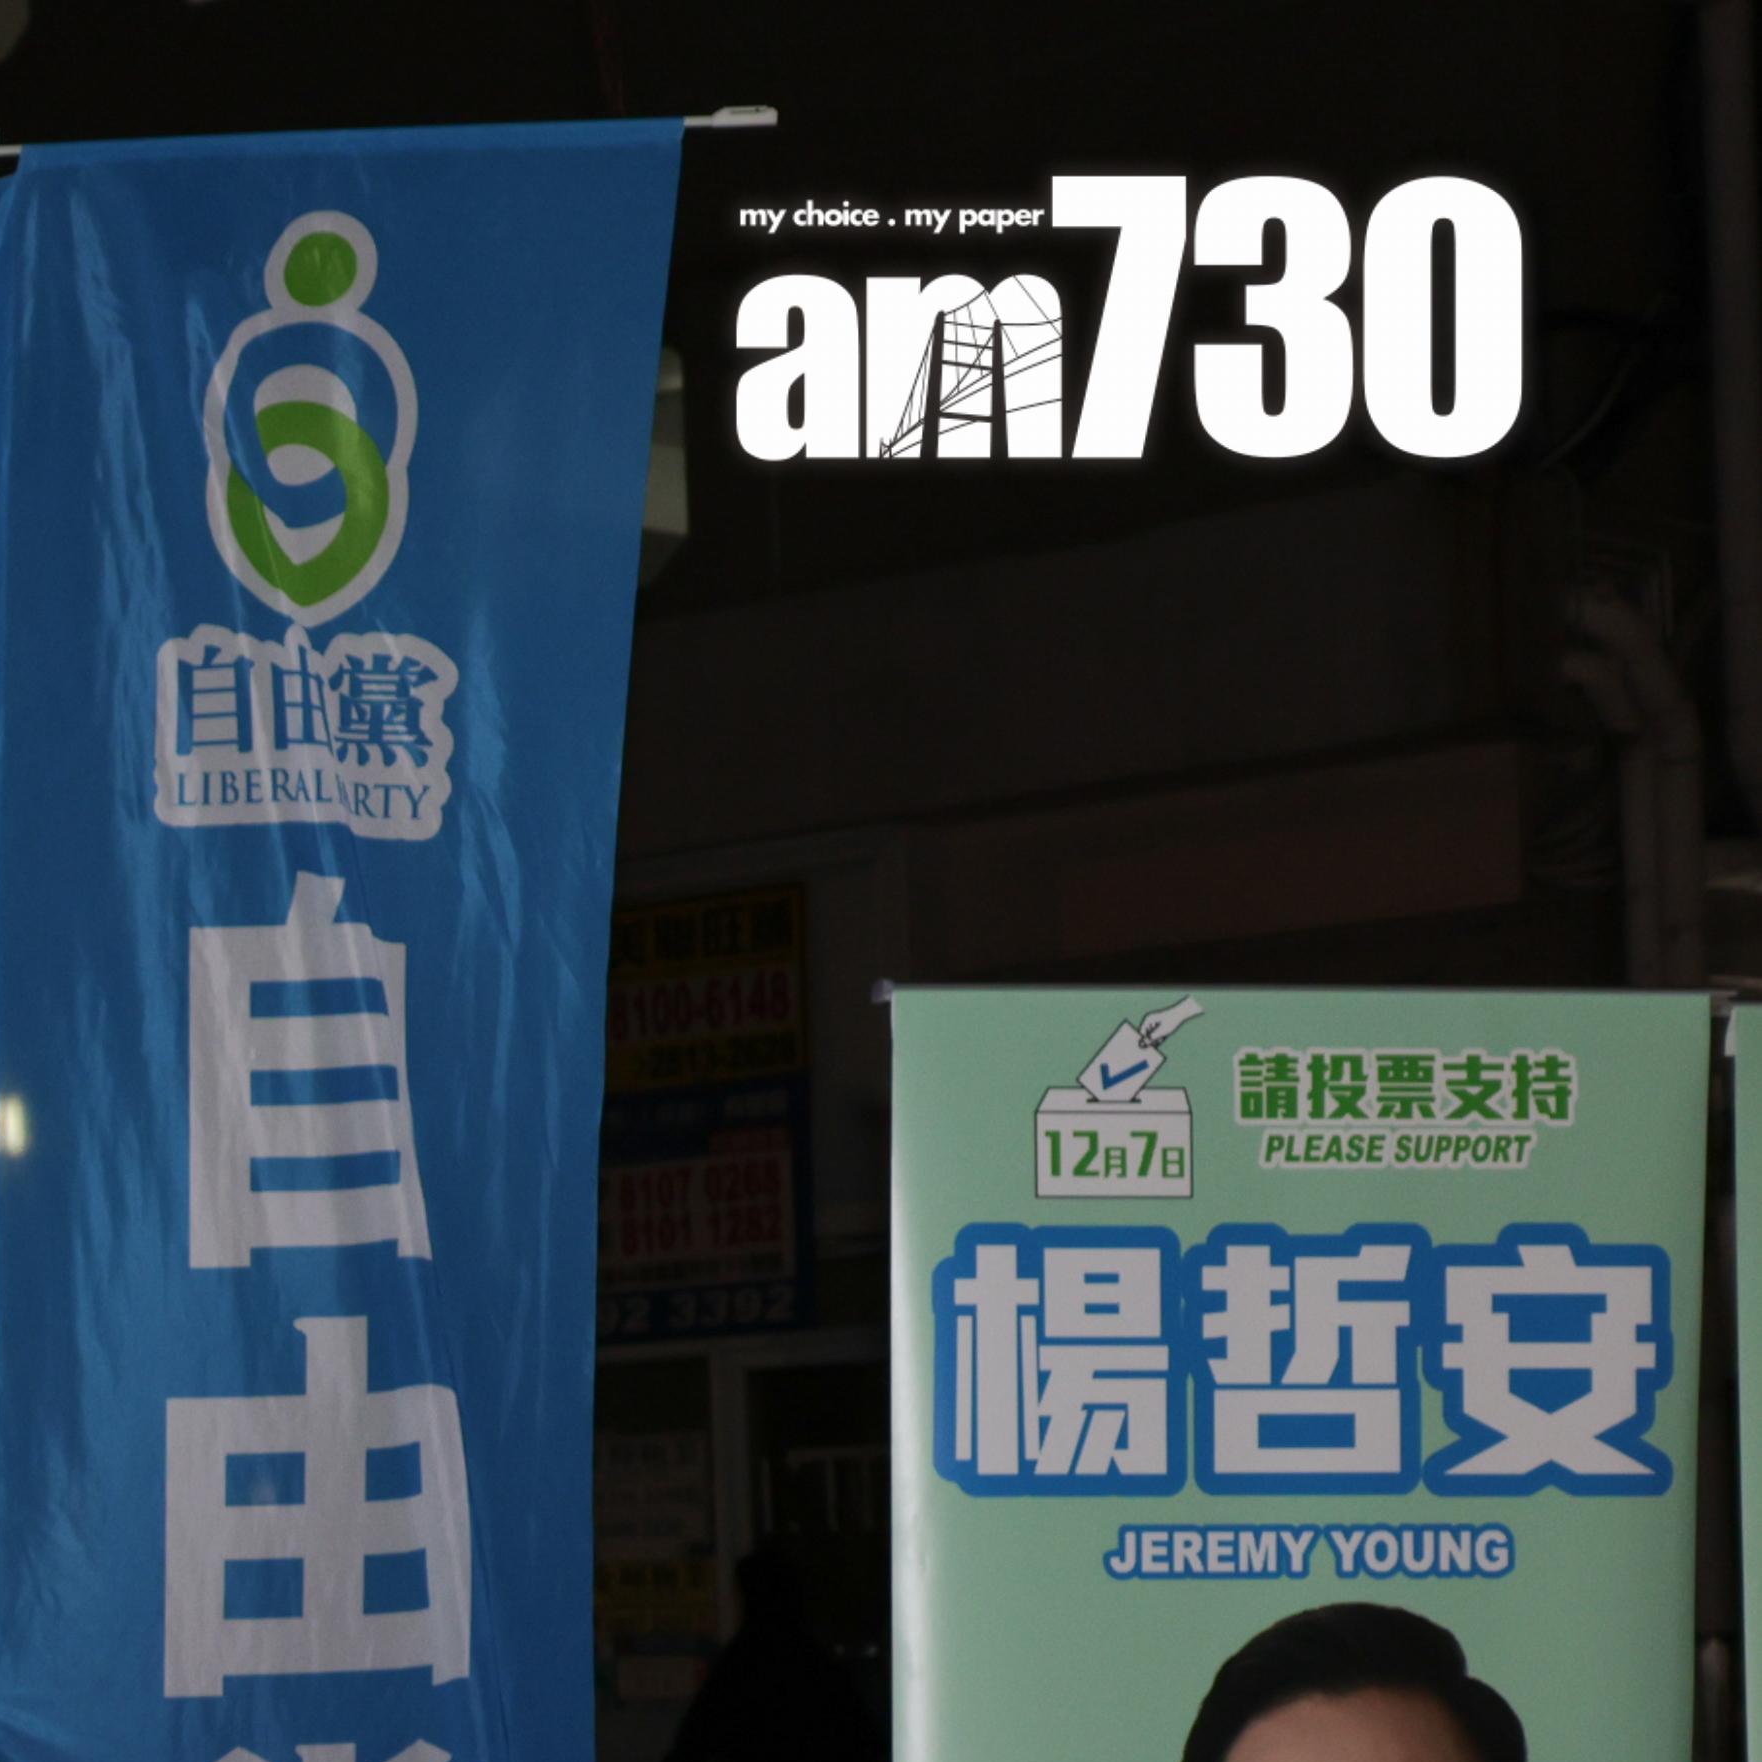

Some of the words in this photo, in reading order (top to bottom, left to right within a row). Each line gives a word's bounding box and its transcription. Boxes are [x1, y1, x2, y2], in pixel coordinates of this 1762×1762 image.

[177, 768, 333, 806] LIBERAL
[1238, 1054, 1572, 1121] 請投票支持
[1045, 1130, 1185, 1179] 12月7日
[1265, 1135, 1386, 1163] PLEASE
[1394, 1135, 1530, 1164] SUPPORT
[953, 1242, 1659, 1477] 楊哲安
[1110, 1531, 1314, 1574] JEREMY
[1330, 1530, 1510, 1573] YOUNG
